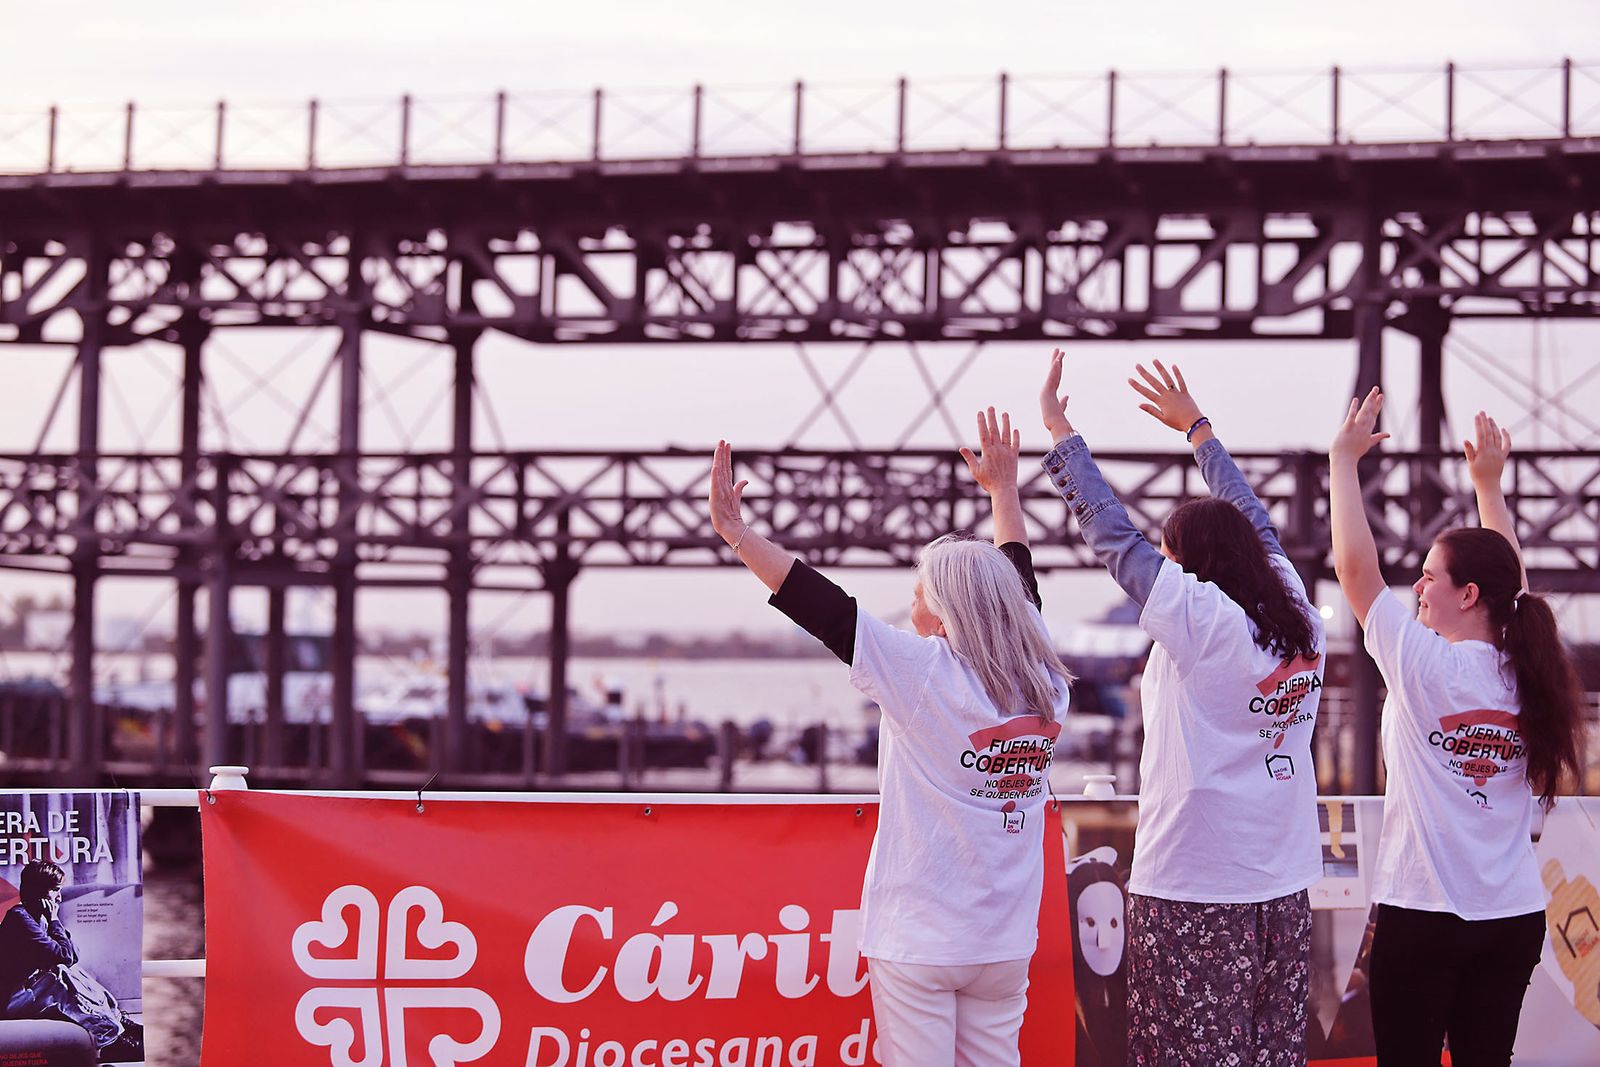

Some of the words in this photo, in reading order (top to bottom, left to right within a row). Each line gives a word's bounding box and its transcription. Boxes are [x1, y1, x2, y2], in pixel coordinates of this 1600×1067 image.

[1276, 675, 1310, 695] FUERA
[1259, 729, 1272, 739] SE
[1456, 723, 1501, 742] FUERA
[1504, 730, 1520, 742] DE
[989, 739, 1037, 754] FUERA
[1428, 731, 1528, 760] COBERTURA
[1449, 759, 1462, 769] NO
[1464, 763, 1491, 773] DEJES
[1492, 765, 1508, 774] QUE
[984, 780, 998, 788] NO
[1000, 779, 1025, 788] DEJES
[1026, 777, 1042, 787] QUE
[970, 788, 984, 797] SE
[985, 791, 1019, 799] QUEDEN
[48, 810, 79, 832] DE
[524, 901, 869, 1003] Cárit
[525, 1026, 818, 1067] Diocesana
